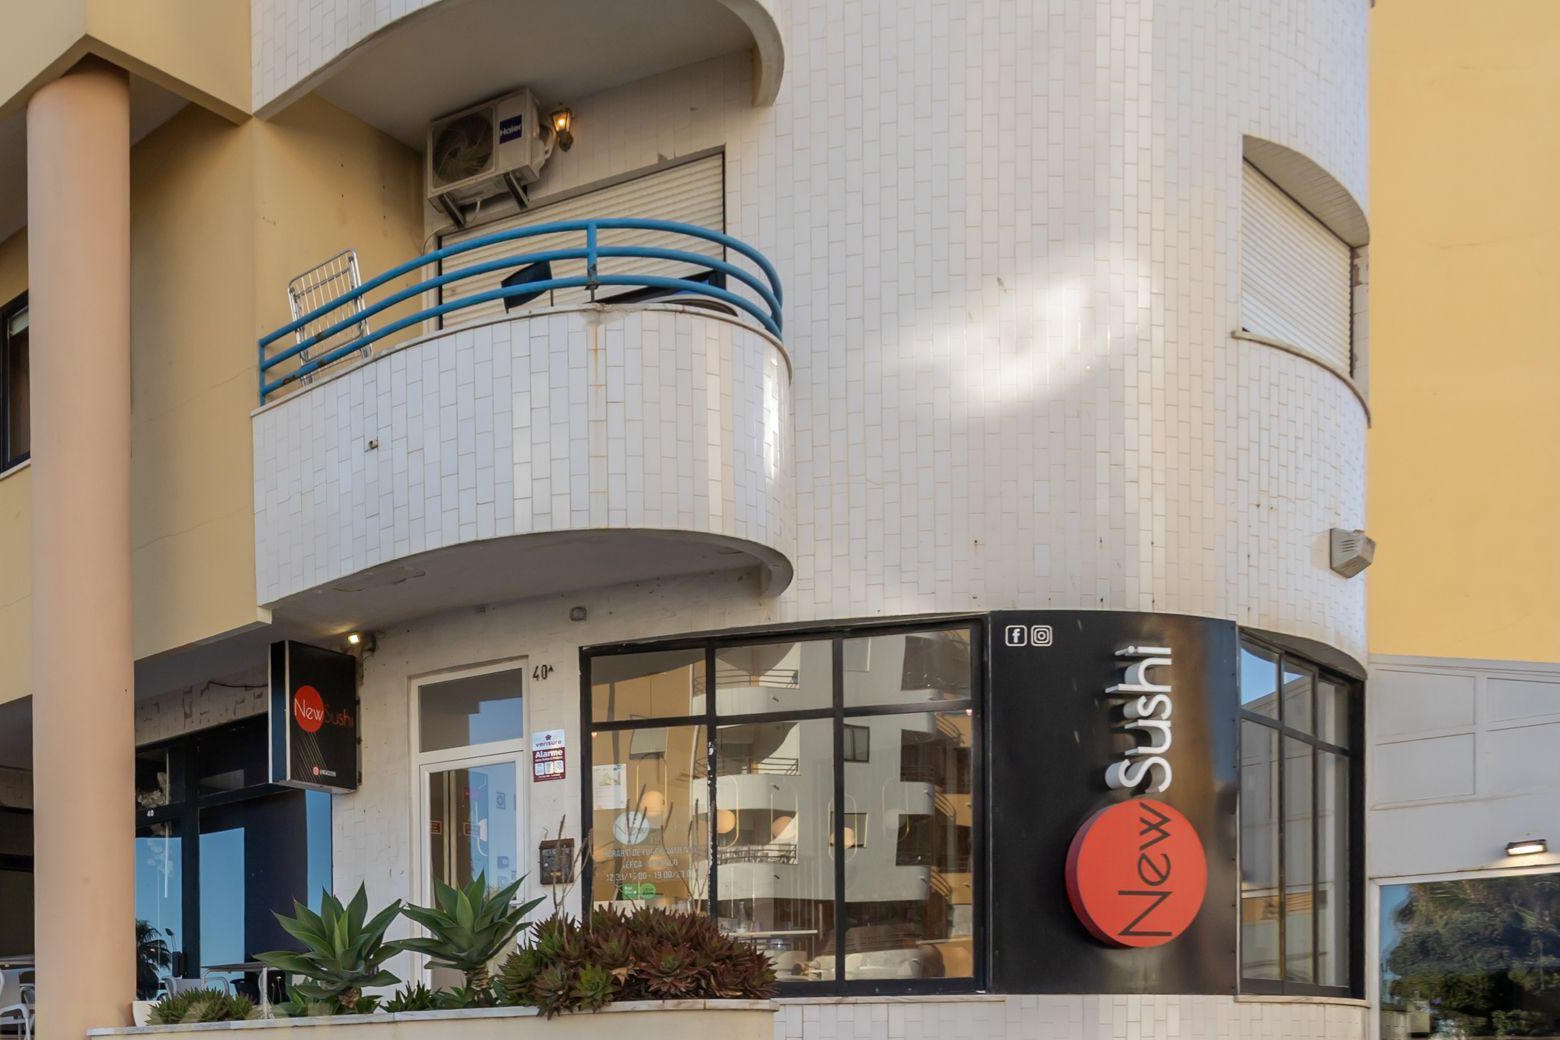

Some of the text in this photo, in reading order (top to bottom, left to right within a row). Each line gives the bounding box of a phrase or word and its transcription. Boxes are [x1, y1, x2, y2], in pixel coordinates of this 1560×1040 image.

[500, 123, 522, 136] Haier
[294, 698, 325, 720] New
[536, 749, 563, 758] Alarme
[1106, 646, 1173, 938] New Sushi
